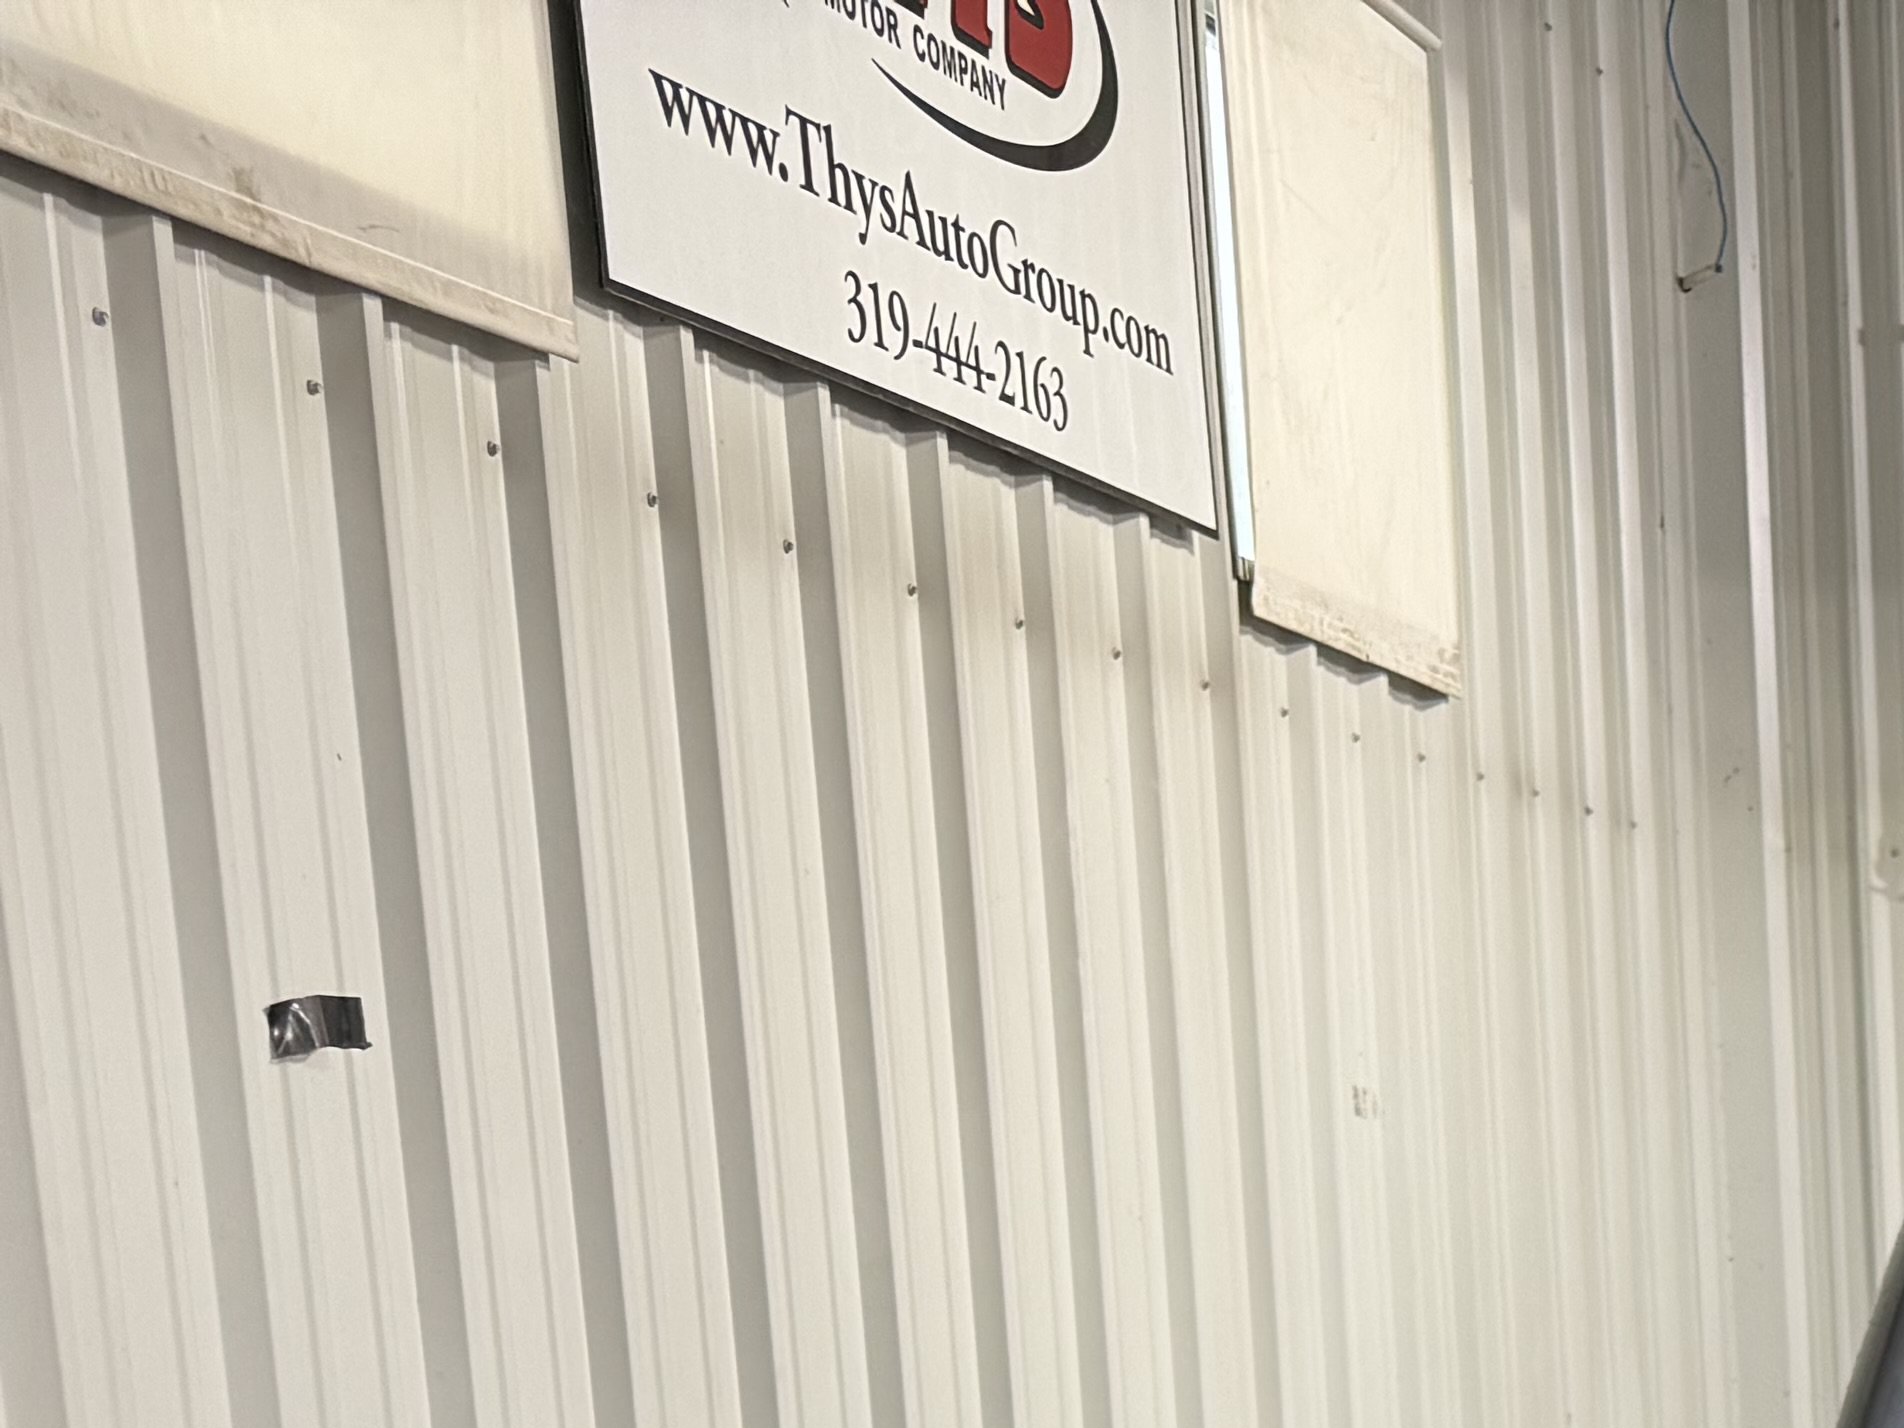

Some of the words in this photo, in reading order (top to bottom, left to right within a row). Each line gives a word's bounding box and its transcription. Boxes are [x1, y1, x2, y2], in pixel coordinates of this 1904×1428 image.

[913, 24, 1006, 110] COMPANY
[648, 68, 1174, 376] www.ThysAutoGroup.com
[845, 270, 1070, 432] 319-444-2163
